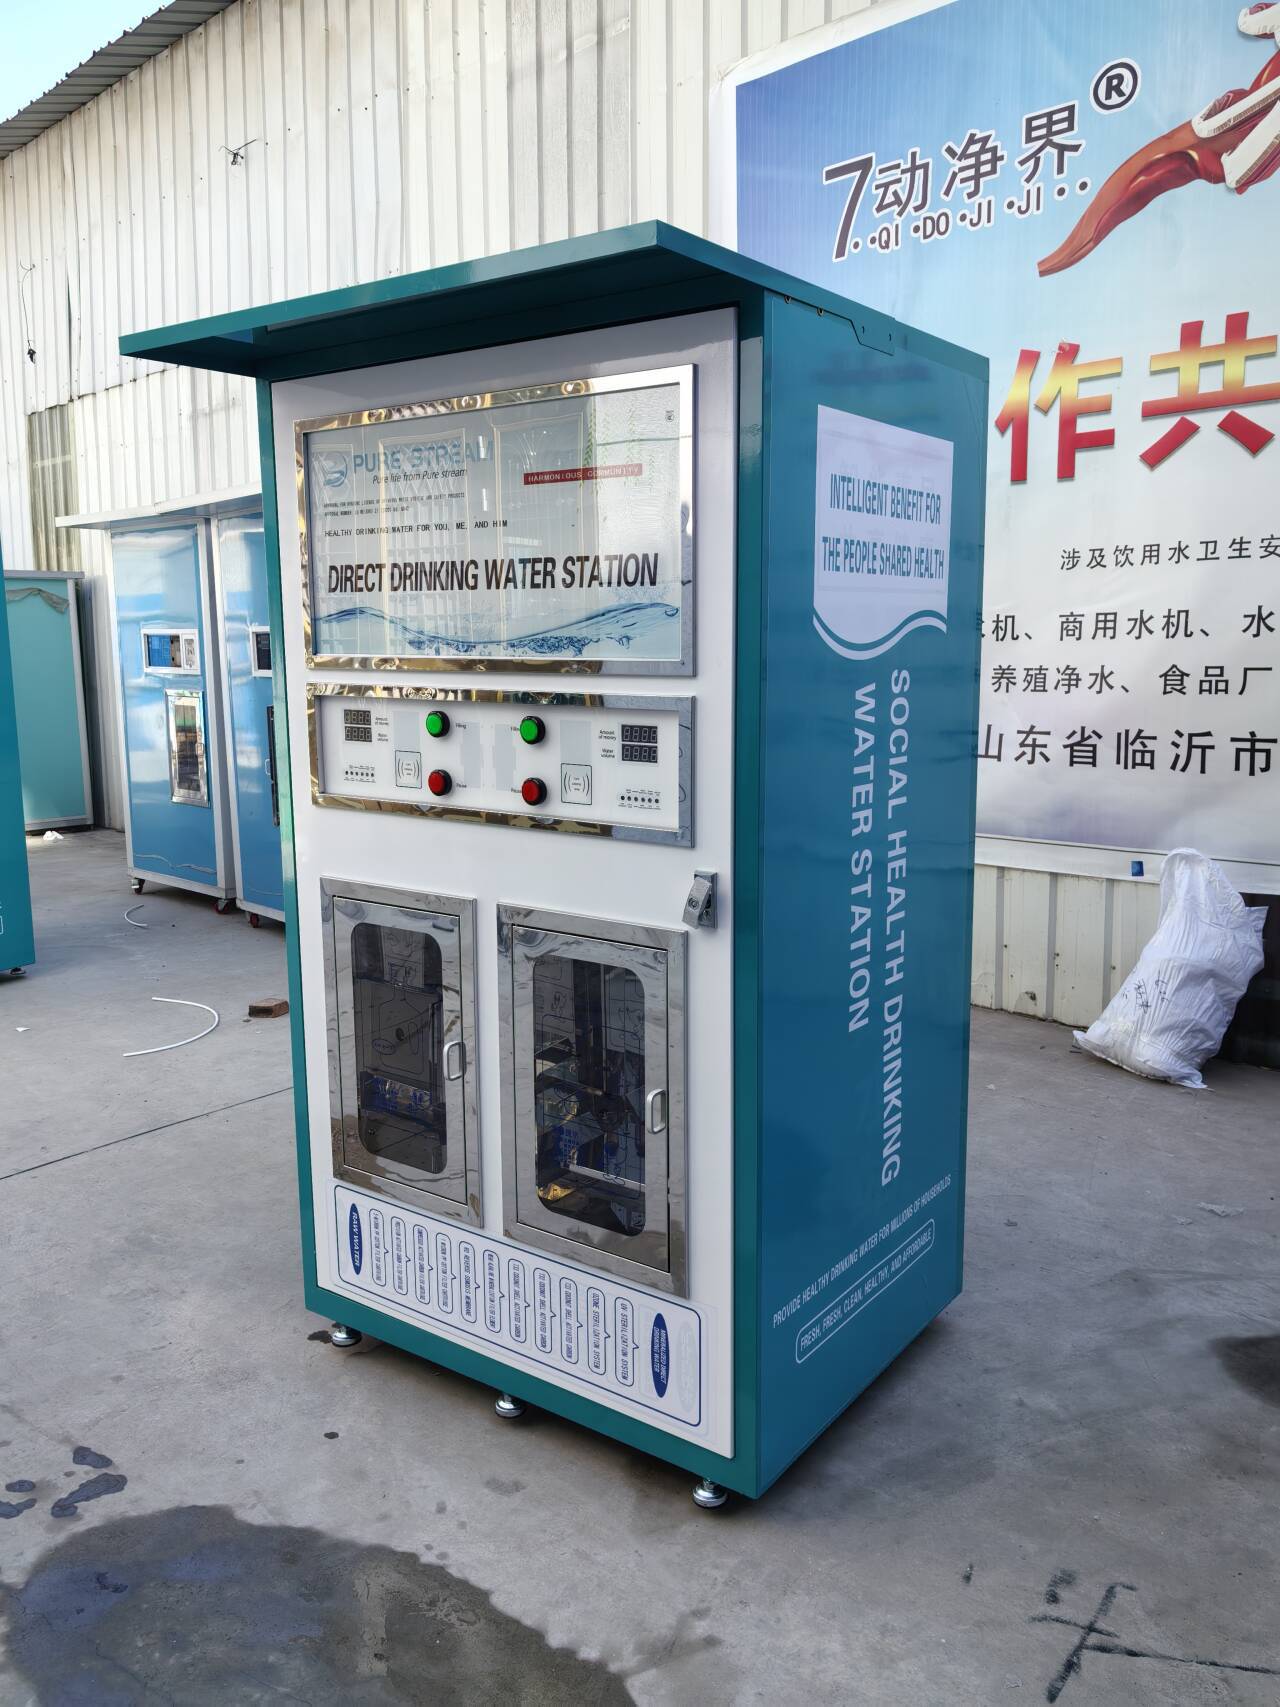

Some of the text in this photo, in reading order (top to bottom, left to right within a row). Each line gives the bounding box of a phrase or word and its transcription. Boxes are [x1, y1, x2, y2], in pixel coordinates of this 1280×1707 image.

[352, 440, 493, 473] PURE STREAM
[372, 468, 466, 485] Pure life from Pure stream
[528, 467, 639, 482] HARMONIOUS COMMUNITY
[830, 473, 941, 525] INTELLIGENT BENEFIT FOR
[325, 529, 352, 537] HEALTHY
[356, 527, 389, 535] DRINKING
[392, 525, 413, 533] WATER
[417, 524, 431, 532] FOR
[474, 521, 489, 529] AND
[328, 553, 658, 593] DIRECT DRINKING WATER STATION
[822, 536, 945, 579] THE PEOPLE SHARED HEALTH
[1060, 534, 1280, 570] 涉及饮用水卫生安
[977, 723, 1278, 777] 山东省临沂市
[848, 682, 876, 1033] WATER STATION
[881, 669, 910, 1187] SOCIAL HEALTH DRINKING
[773, 1174, 951, 1328] PROVIDE HEALTHY DRINKING WATER FOR MILLIONS OF HOUSEHOLDS
[591, 1291, 599, 1309] OZONE
[800, 1228, 932, 1352] FRESH, FRESH, CLEAN, HEALTHY, AND AFFORDABLE
[620, 1302, 628, 1381] UV STERILIZATION SYSTEM
